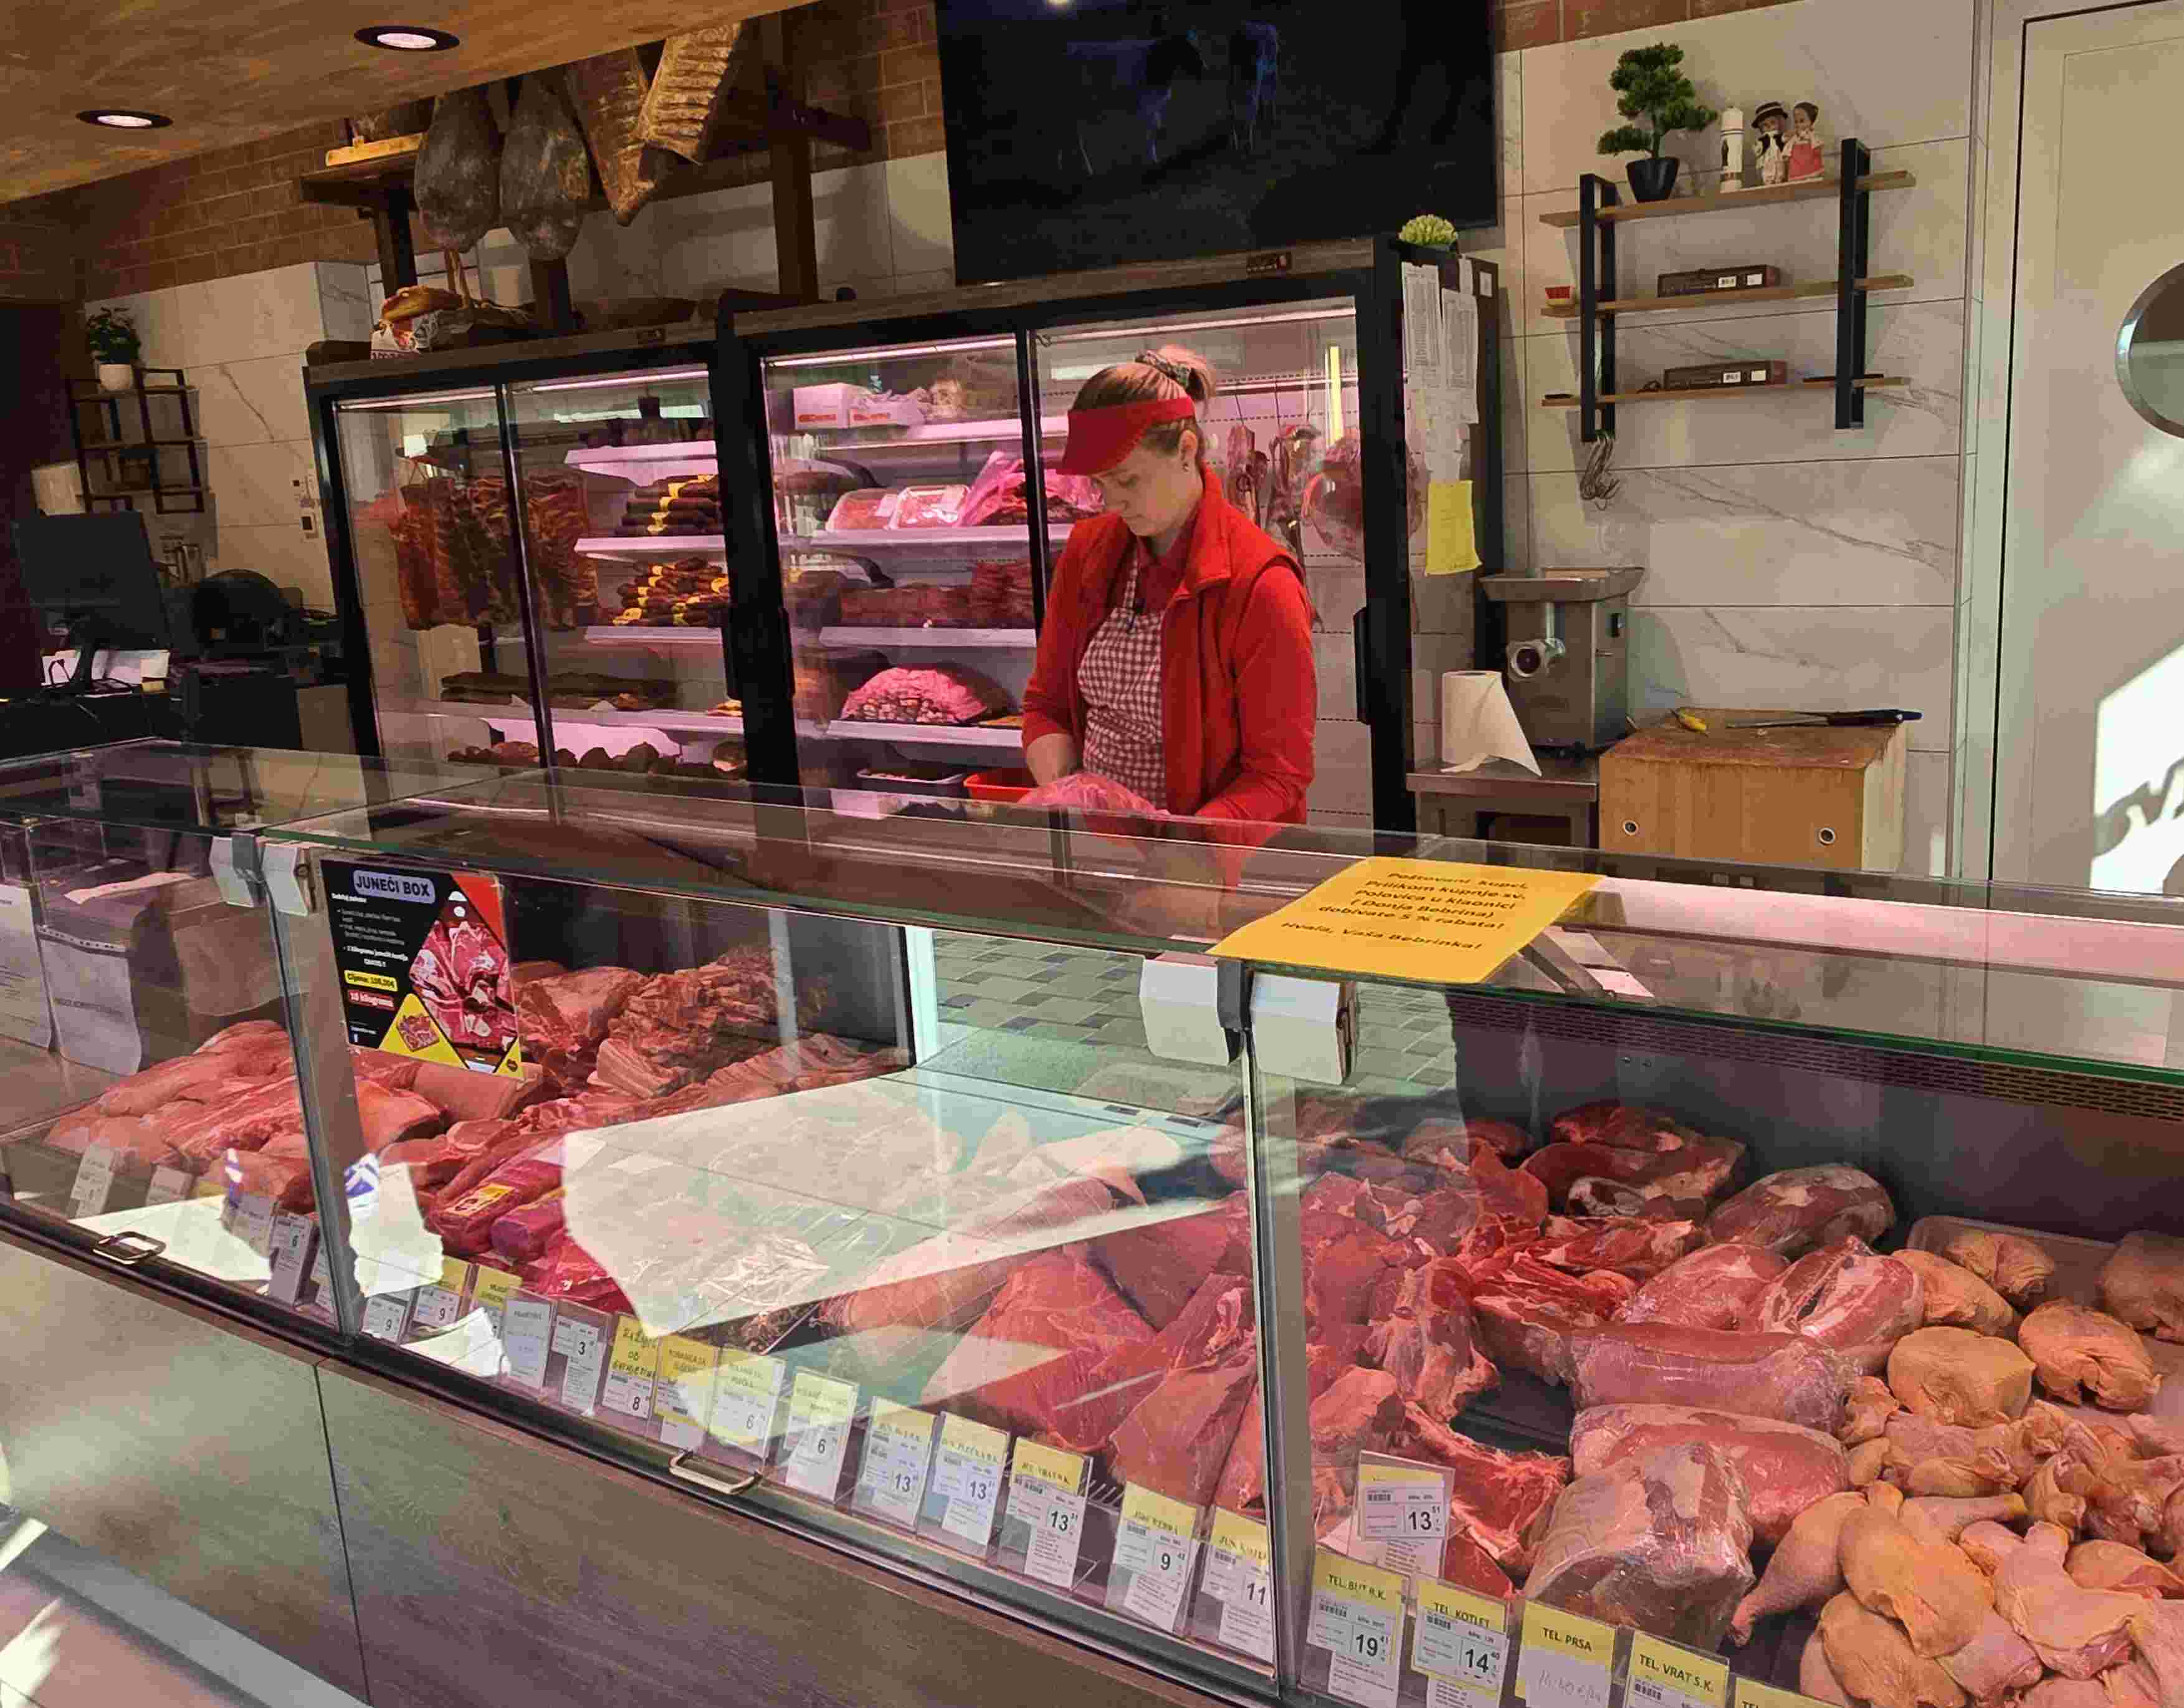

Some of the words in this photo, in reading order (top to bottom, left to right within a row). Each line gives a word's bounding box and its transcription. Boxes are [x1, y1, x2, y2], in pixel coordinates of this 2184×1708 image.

[1387, 873, 1471, 883] Poštovani
[403, 882, 431, 897] BOX
[1365, 880, 1434, 891] Prilikom
[1440, 887, 1499, 897] kupnje
[1355, 890, 1426, 900] Polovica
[1446, 897, 1516, 909] klaonici
[1319, 907, 1396, 917] dobivate
[1435, 918, 1505, 929] rabata!
[1418, 905, 1494, 918] Bebrina)
[1343, 928, 1383, 938] Vaša
[1388, 934, 1483, 949] Bebrinka!
[578, 1341, 586, 1355] 3
[632, 1396, 641, 1411] 8
[818, 1438, 827, 1454] 6
[895, 1473, 911, 1492] 13
[969, 1480, 987, 1500] 13
[1050, 1510, 1069, 1532] 13
[1408, 1510, 1432, 1531] 13
[1160, 1552, 1171, 1571] 9
[1247, 1582, 1266, 1606] 11
[1355, 1633, 1378, 1657] 19
[1565, 1634, 1593, 1652] PRSA
[1465, 1648, 1489, 1673] 14
[1662, 1663, 1693, 1682] VRAT
